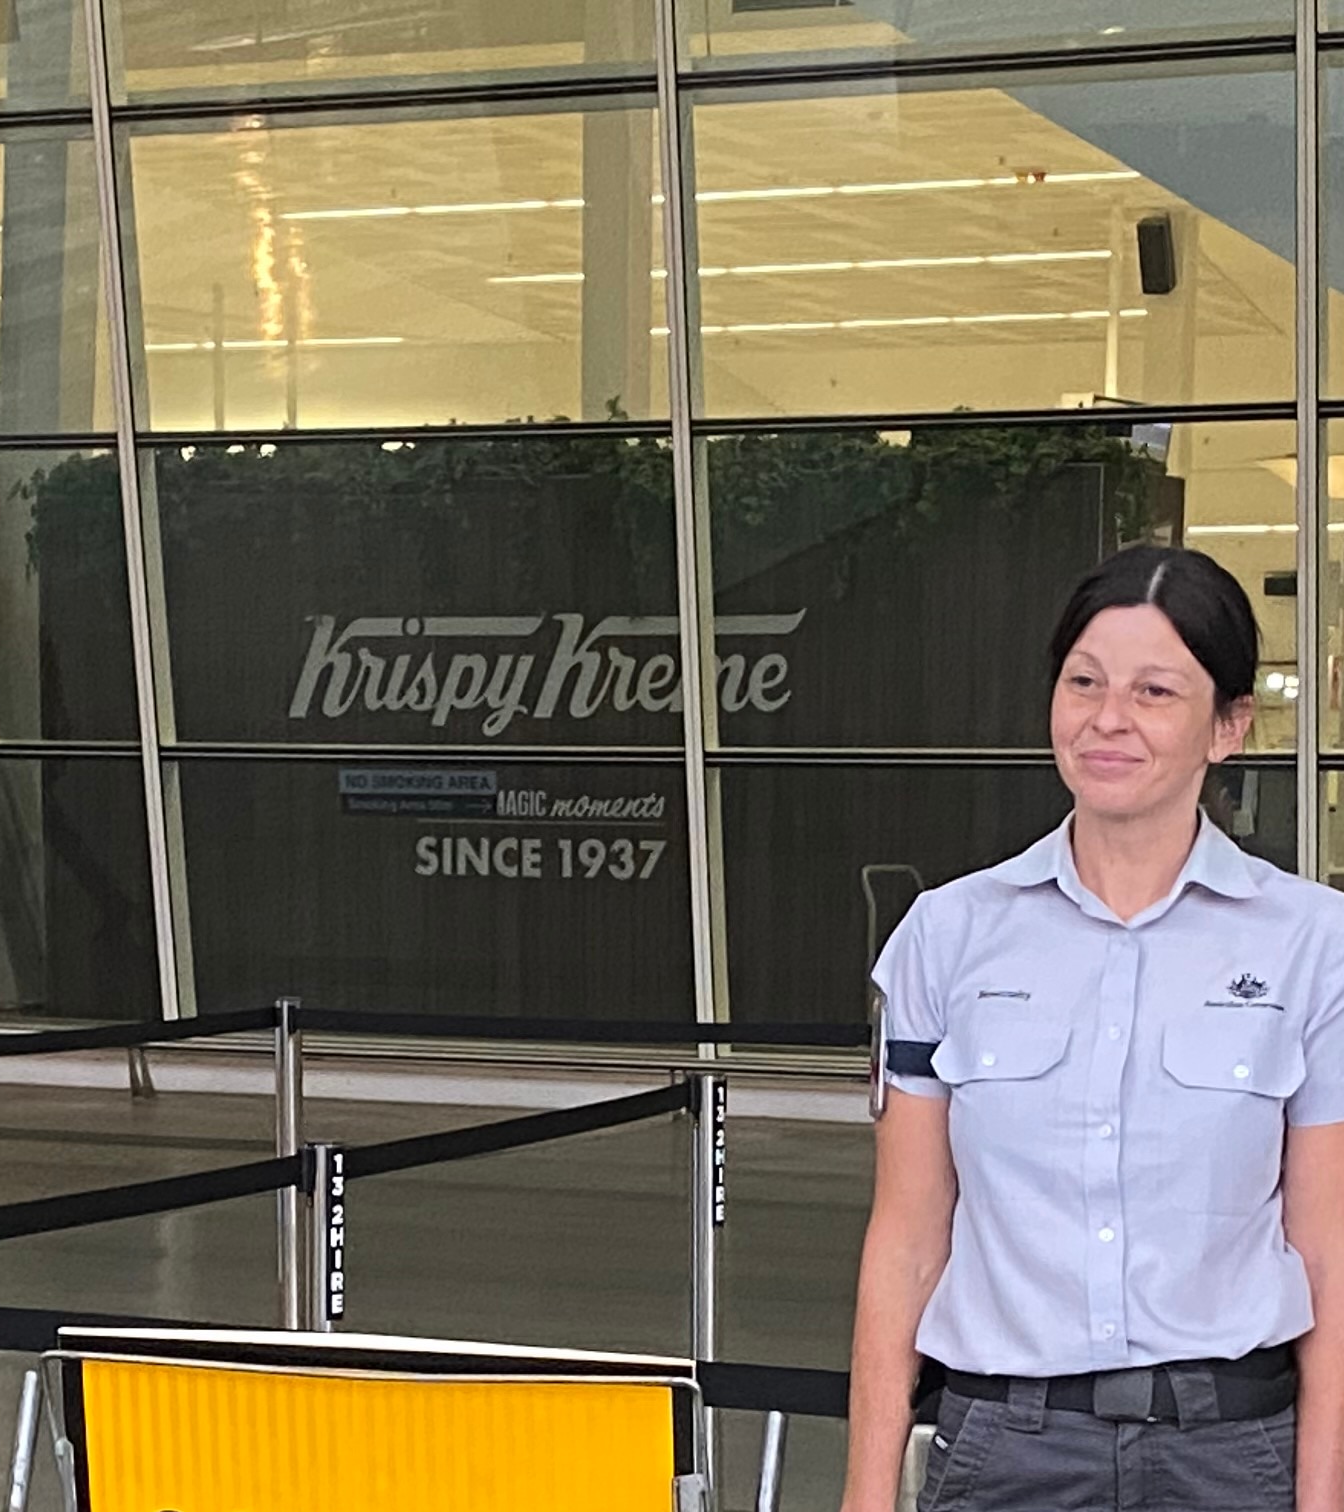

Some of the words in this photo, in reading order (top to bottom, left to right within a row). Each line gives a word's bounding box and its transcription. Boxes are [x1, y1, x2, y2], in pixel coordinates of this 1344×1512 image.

[288, 611, 545, 736] Krispy
[550, 792, 664, 818] moments
[415, 836, 542, 879] SINCE
[558, 838, 668, 880] 1937
